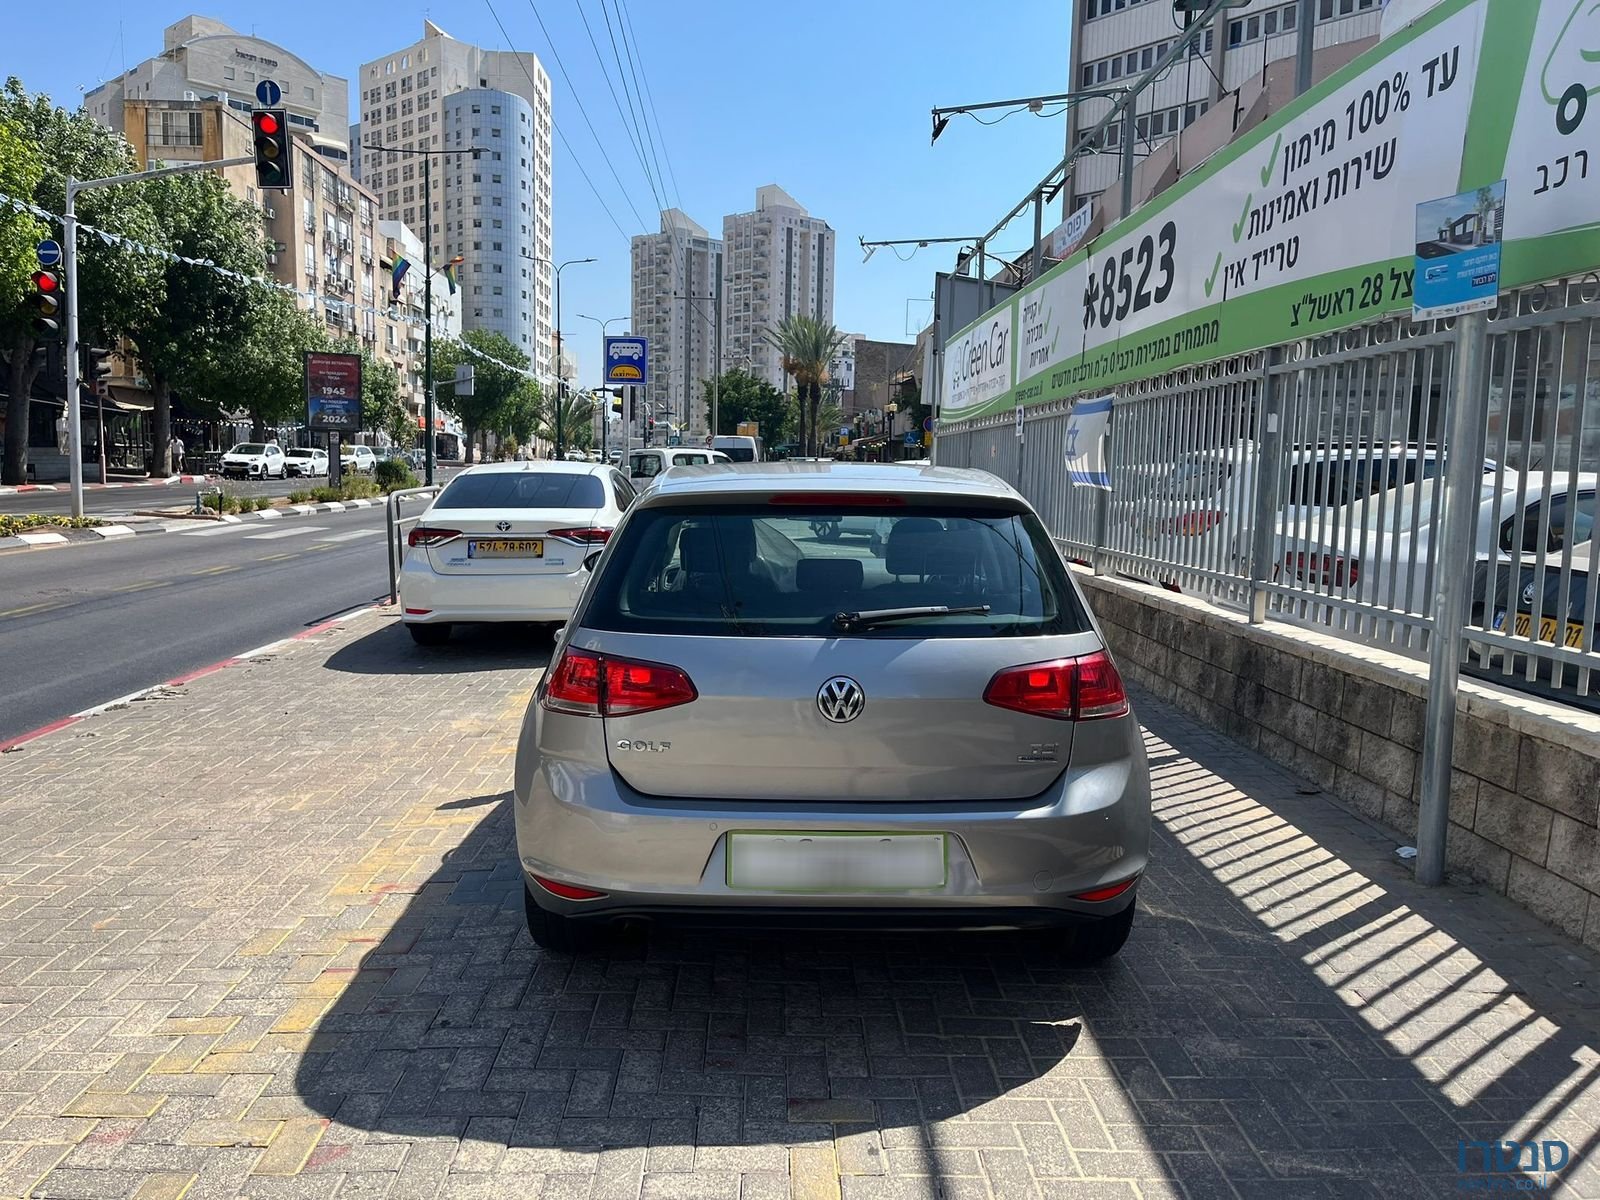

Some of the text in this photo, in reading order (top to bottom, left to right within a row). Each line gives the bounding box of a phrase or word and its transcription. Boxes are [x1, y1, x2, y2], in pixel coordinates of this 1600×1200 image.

[1282, 45, 1460, 186] עד 100% מימון
[1533, 149, 1588, 195] רכב
[1247, 137, 1397, 240] שירות ואמינות
[1067, 209, 1087, 237] דפוס
[1222, 235, 1300, 302] טרייד אין
[1358, 272, 1383, 310] 28
[1389, 266, 1415, 301] צל
[989, 321, 1009, 369] Car
[1026, 322, 1043, 346] מכירה
[1173, 319, 1219, 354] מתמחים
[1029, 344, 1050, 369] אחריות
[1116, 349, 1134, 371] רכבי
[1135, 337, 1170, 367] במכירת
[1051, 369, 1071, 389] חדשים
[1072, 362, 1093, 383] ורכבים
[322, 386, 346, 395] 1945
[322, 415, 348, 424] 2024
[616, 738, 672, 753] GOLF
